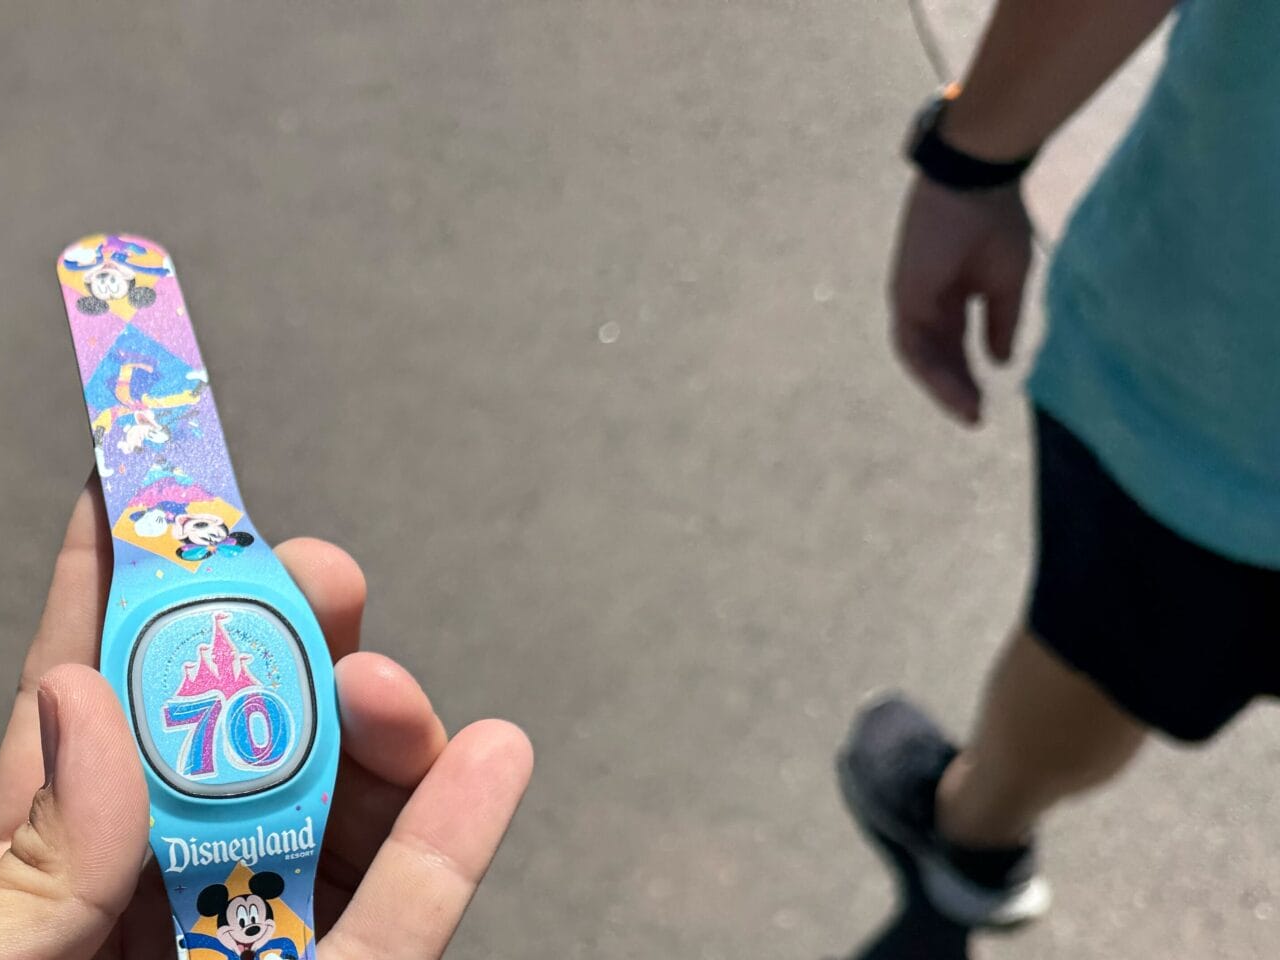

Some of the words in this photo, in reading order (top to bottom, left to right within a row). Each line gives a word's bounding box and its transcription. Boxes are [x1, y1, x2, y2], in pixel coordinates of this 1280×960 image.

[162, 689, 295, 779] 70
[160, 816, 316, 873] Disneyland
[284, 850, 314, 860] RESORT
